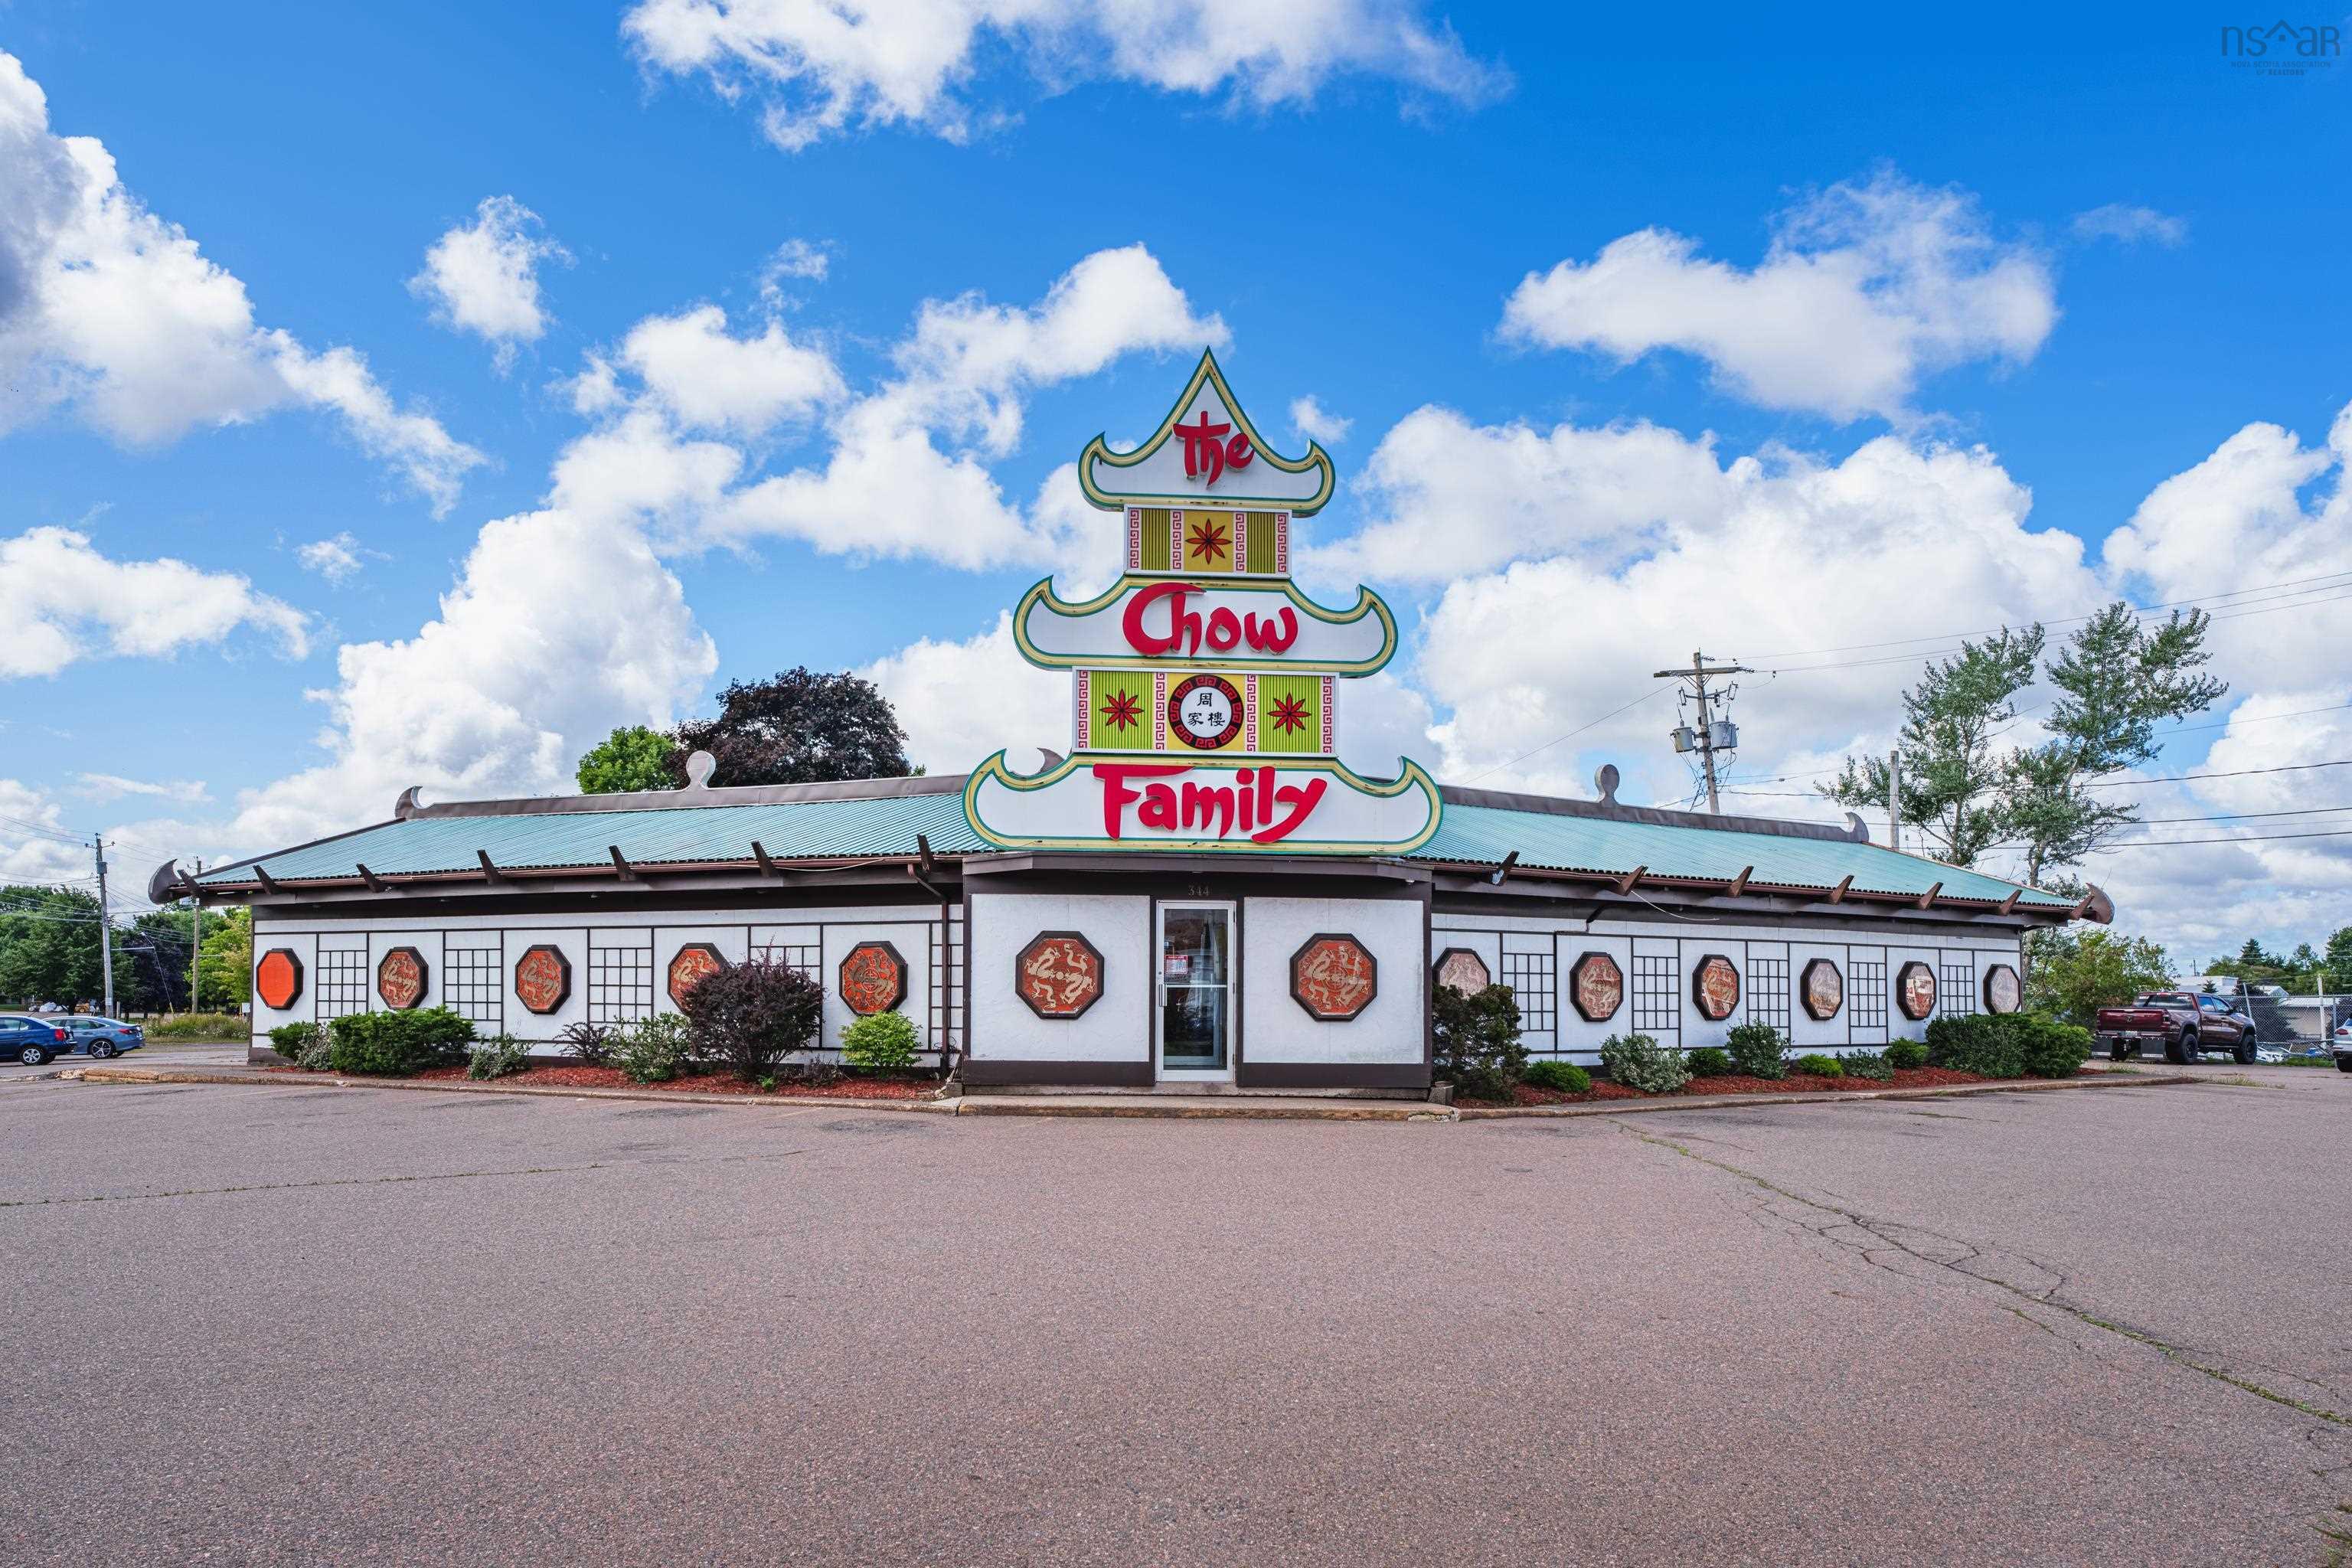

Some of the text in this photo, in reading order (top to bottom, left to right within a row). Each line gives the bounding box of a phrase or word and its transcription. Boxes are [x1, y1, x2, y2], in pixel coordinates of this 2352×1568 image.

[1173, 411, 1255, 485] The
[1122, 582, 1298, 658] Chow
[1197, 692, 1213, 707] 周
[1093, 763, 1328, 844] Family
